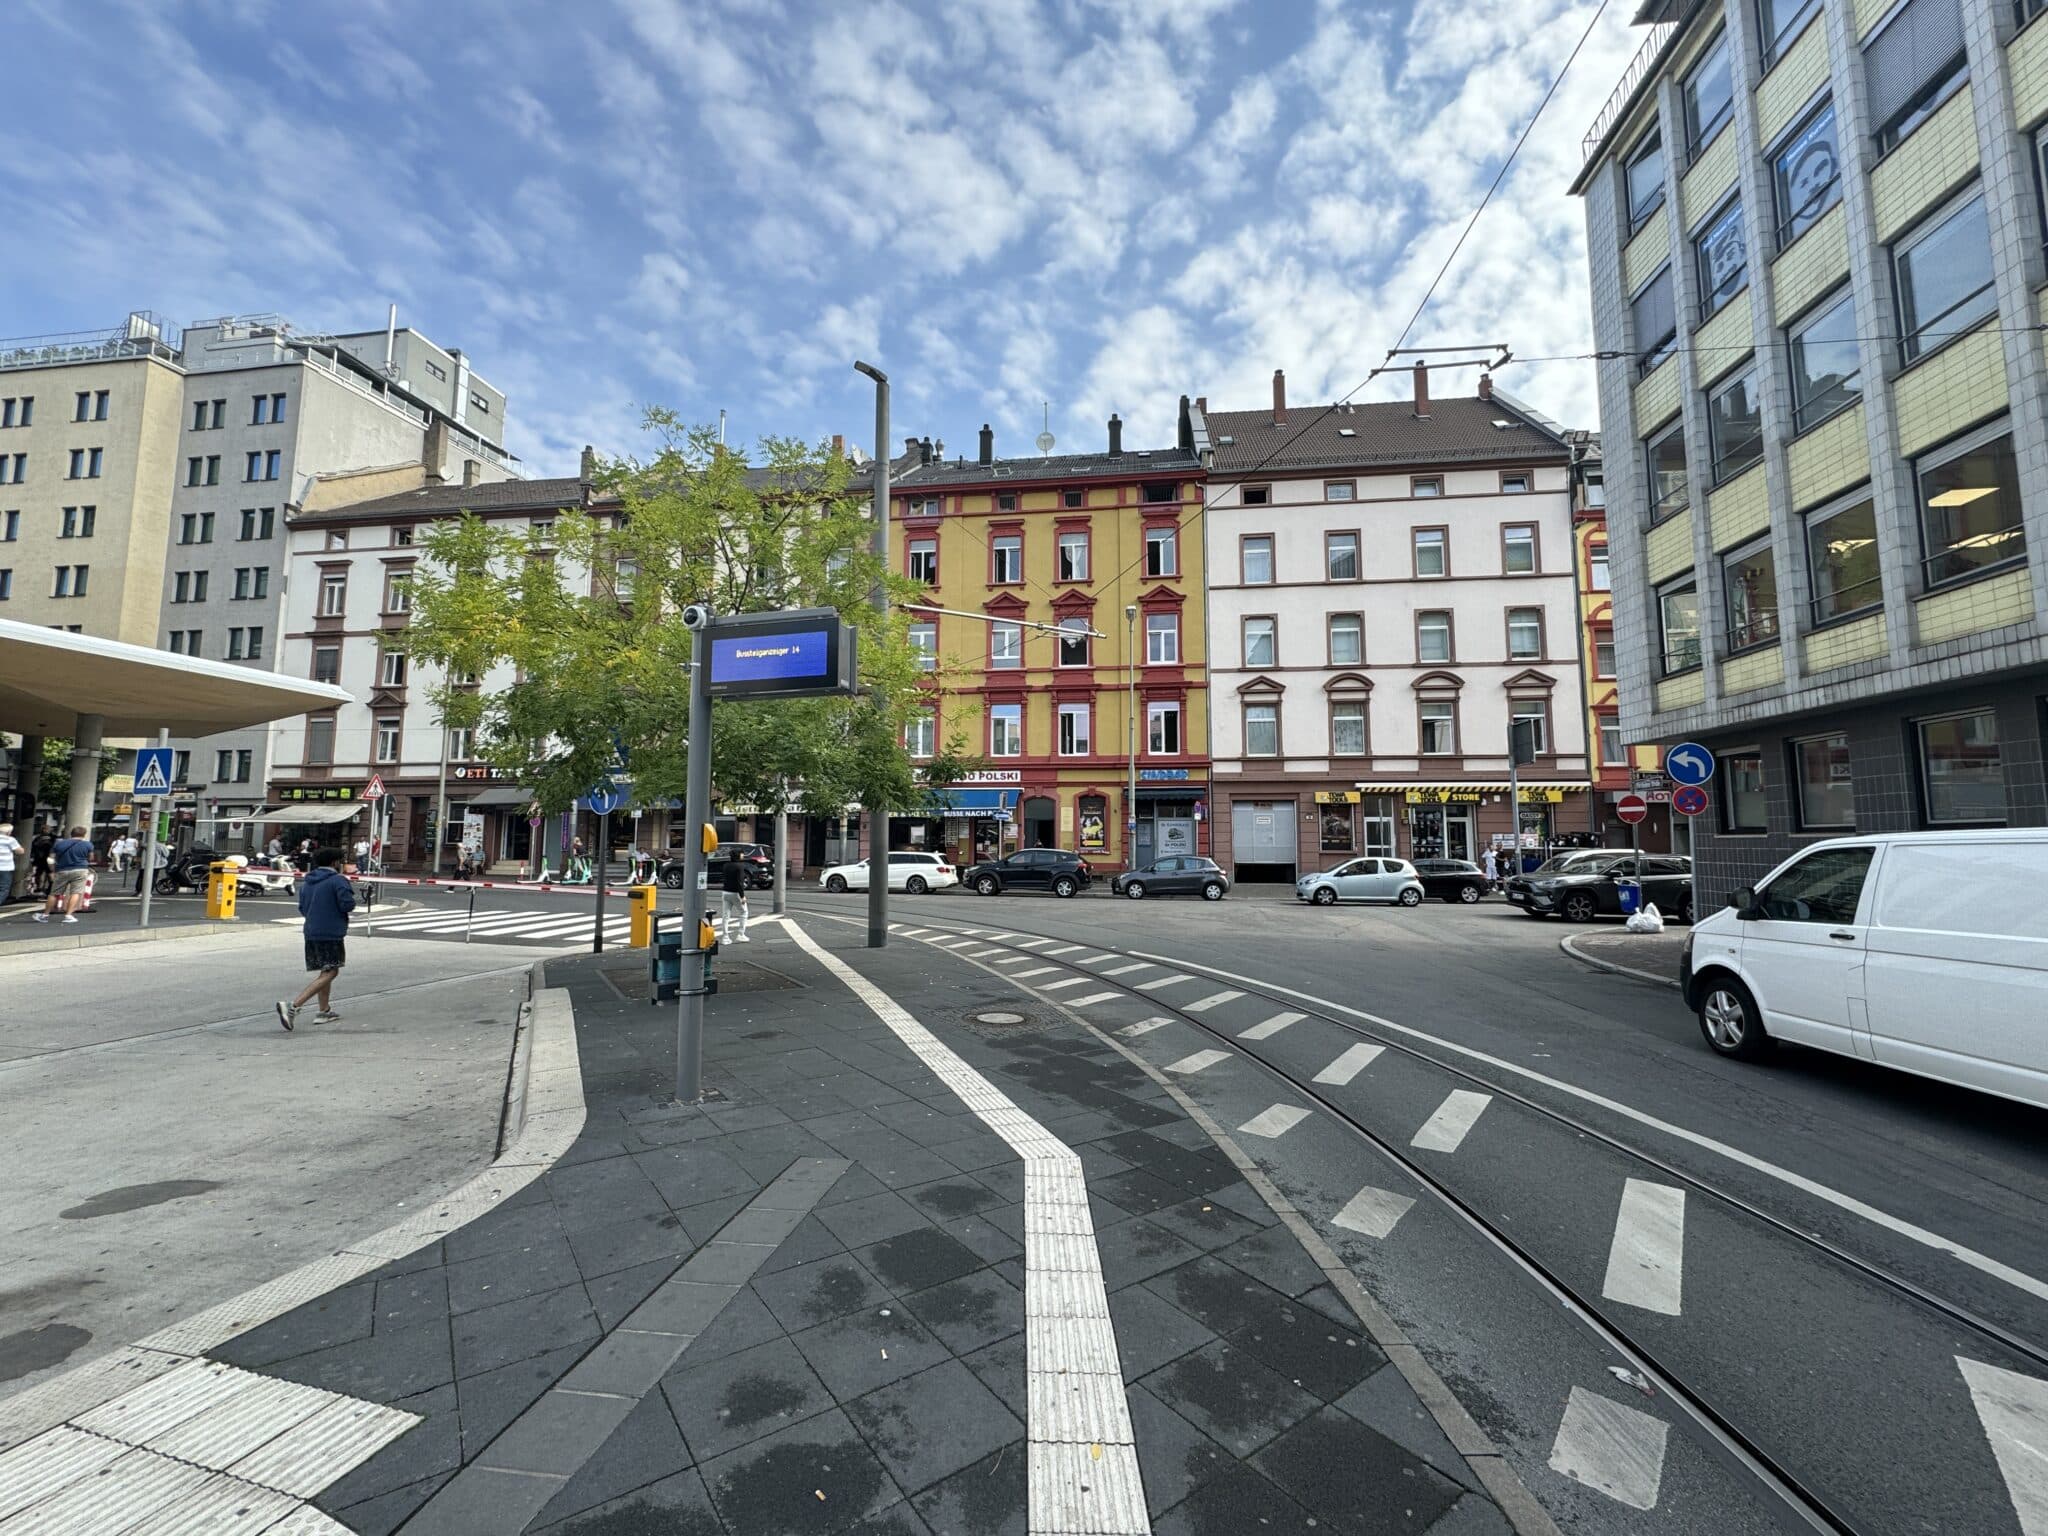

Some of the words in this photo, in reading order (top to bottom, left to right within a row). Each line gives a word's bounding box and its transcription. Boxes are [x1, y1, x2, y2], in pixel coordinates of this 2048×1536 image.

[736, 648, 789, 658] Bussteiganzeiger
[978, 772, 1018, 781] POLSKI
[1452, 793, 1480, 801] STORE
